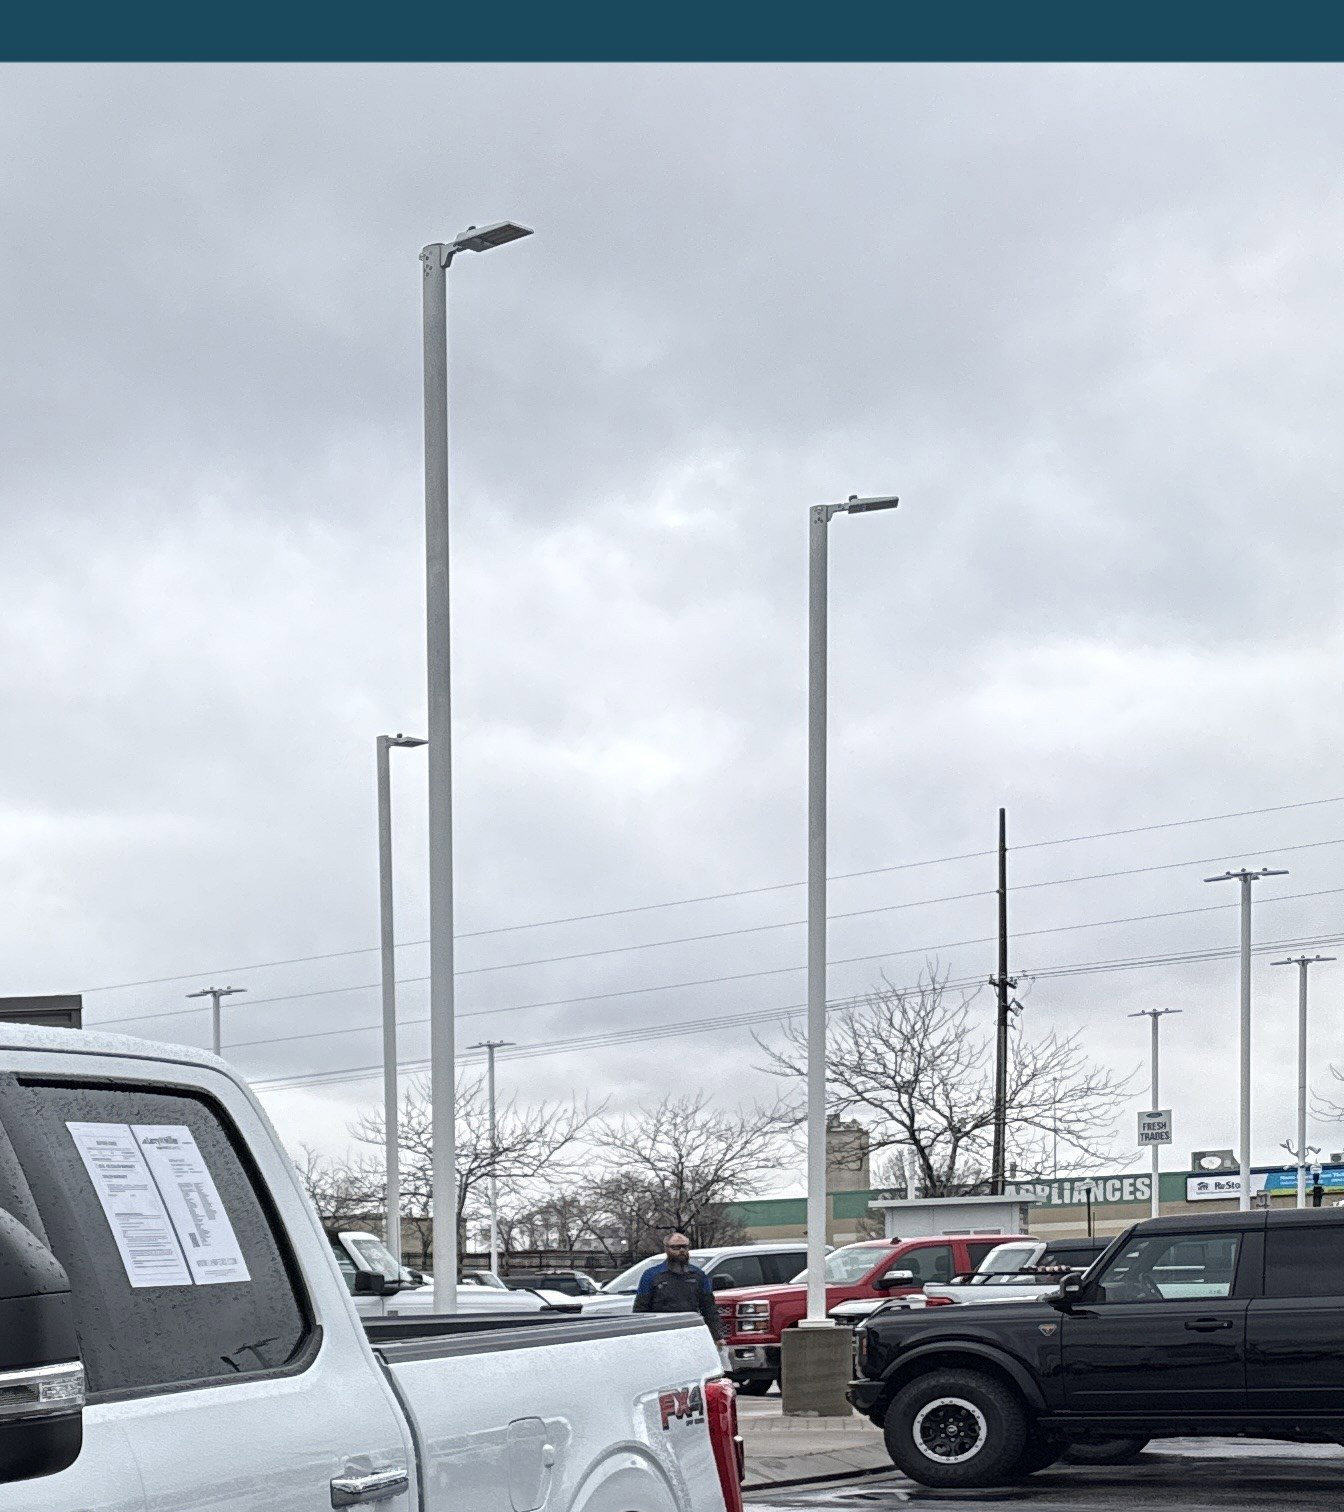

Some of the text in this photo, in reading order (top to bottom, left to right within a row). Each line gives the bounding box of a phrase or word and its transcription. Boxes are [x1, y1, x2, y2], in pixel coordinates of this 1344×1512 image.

[1142, 1121, 1167, 1131] FRESH
[1140, 1131, 1170, 1142] TRADES
[658, 1386, 704, 1431] FX4
